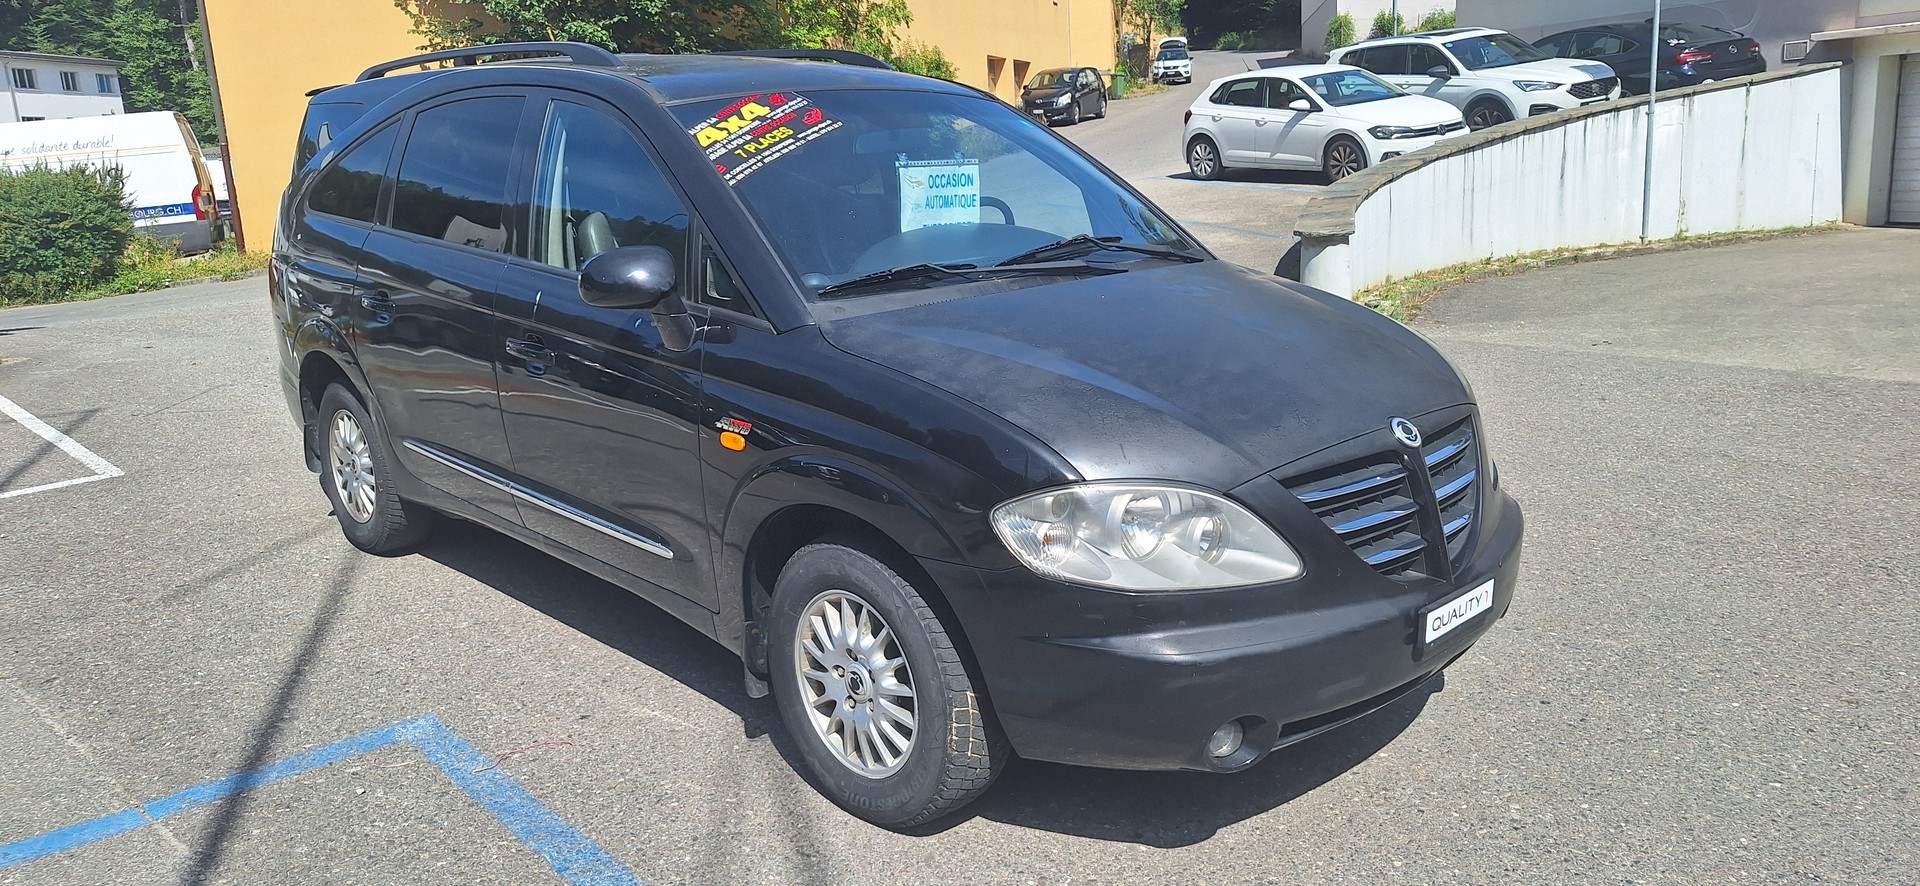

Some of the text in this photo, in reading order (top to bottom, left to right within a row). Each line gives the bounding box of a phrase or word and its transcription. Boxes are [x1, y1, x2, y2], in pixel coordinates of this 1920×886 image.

[734, 126, 794, 159] 7 PLACES
[928, 173, 974, 189] OCCASION
[925, 194, 977, 210] AUTOMATIQUE
